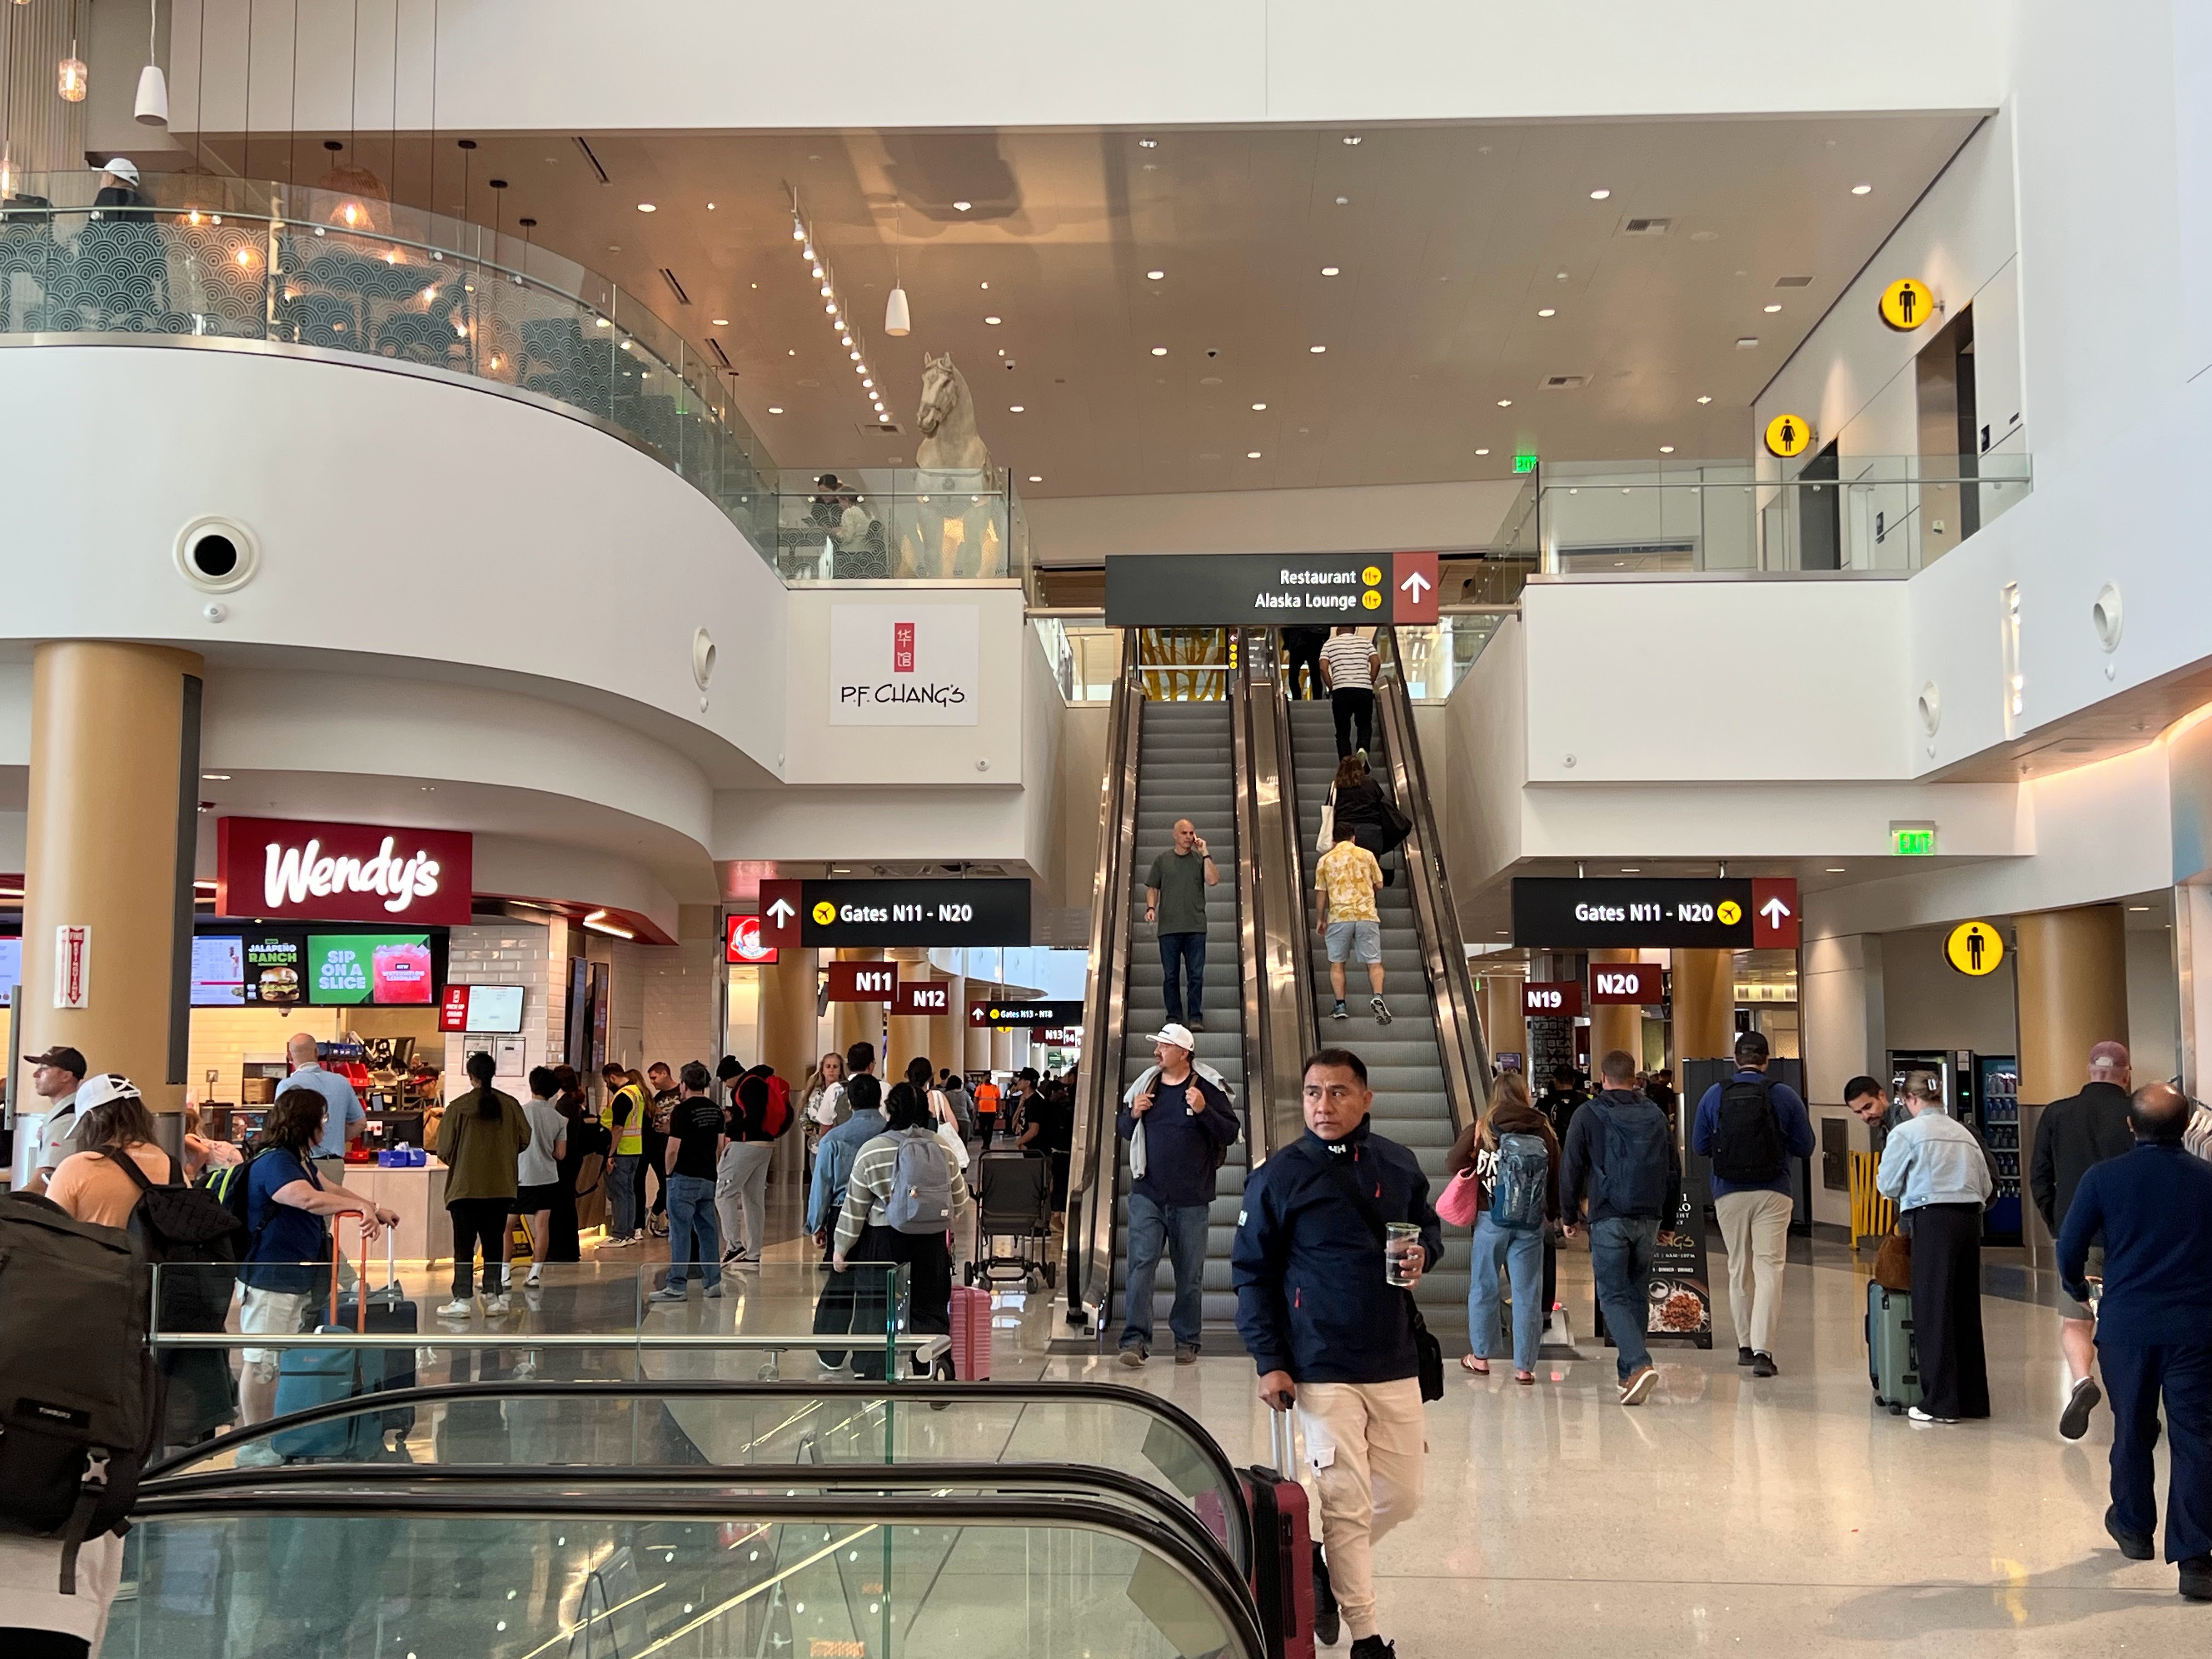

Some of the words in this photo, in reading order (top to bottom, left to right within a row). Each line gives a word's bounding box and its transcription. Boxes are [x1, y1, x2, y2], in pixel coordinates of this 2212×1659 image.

[1281, 569, 1356, 584] Restaurant
[1255, 592, 1301, 607] Alaska
[1306, 592, 1356, 611] Lounge
[898, 629, 911, 667] 华馆
[842, 686, 870, 707] P.F.
[874, 683, 965, 708] CHANG'S
[1899, 833, 1931, 853] EXIT
[264, 836, 440, 913] Wendy's
[840, 904, 888, 921] Gates
[893, 904, 922, 921] N11
[939, 904, 972, 921] N20
[1575, 904, 1625, 922] Gates
[1630, 904, 1660, 921] N11
[1678, 904, 1713, 921] N20
[249, 953, 297, 963] RANCH
[328, 950, 356, 964] SIP
[321, 963, 347, 977] ON
[350, 963, 363, 977] A
[319, 977, 366, 990] SLICE
[856, 972, 891, 991] N11
[1597, 974, 1639, 994] N20
[913, 990, 945, 1007] N12
[1528, 991, 1561, 1008] N19
[1000, 1009, 1020, 1018] Gates
[1045, 1029, 1063, 1040] N13
[1065, 1033, 1075, 1043] 14
